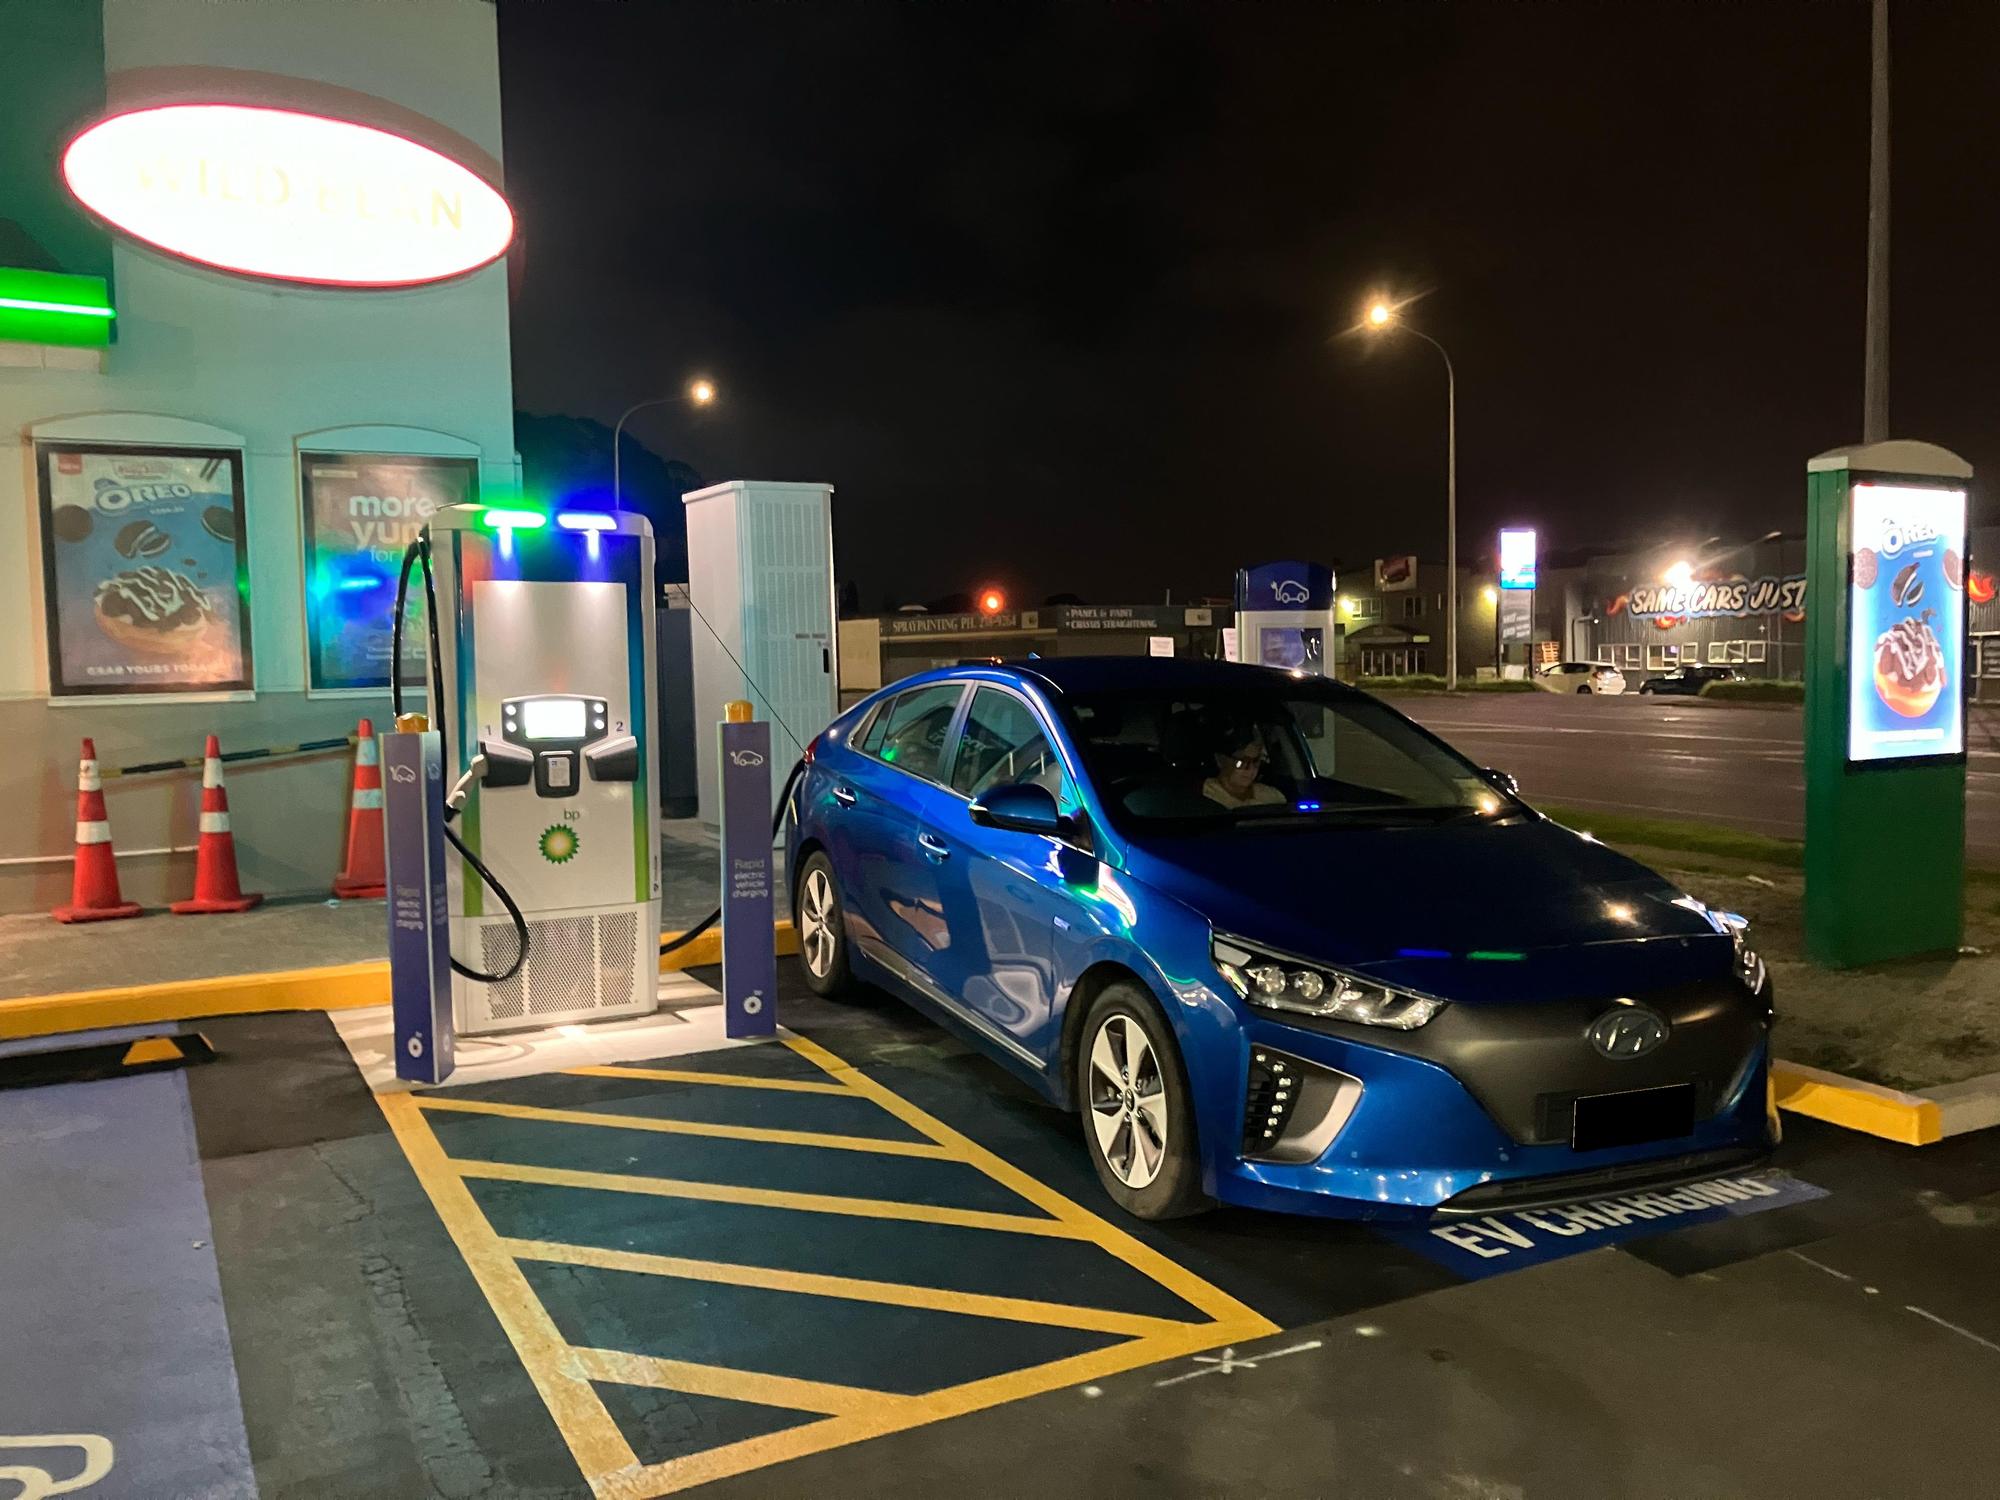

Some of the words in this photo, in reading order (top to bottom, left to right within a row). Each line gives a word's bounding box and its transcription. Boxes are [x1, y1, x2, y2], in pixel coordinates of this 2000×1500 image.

[135, 156, 291, 207] WILD
[97, 482, 192, 512] OREO
[350, 494, 437, 517] more
[370, 544, 395, 562] for
[1631, 586, 1686, 614] SAME
[1690, 582, 1748, 612] CARS
[1750, 579, 1808, 610] JUST
[86, 665, 125, 676] GRAB
[126, 663, 170, 675] YOURS
[174, 662, 216, 673] TODA
[615, 721, 624, 732] 2
[563, 807, 581, 822] bp
[1429, 1216, 1535, 1259] EV
